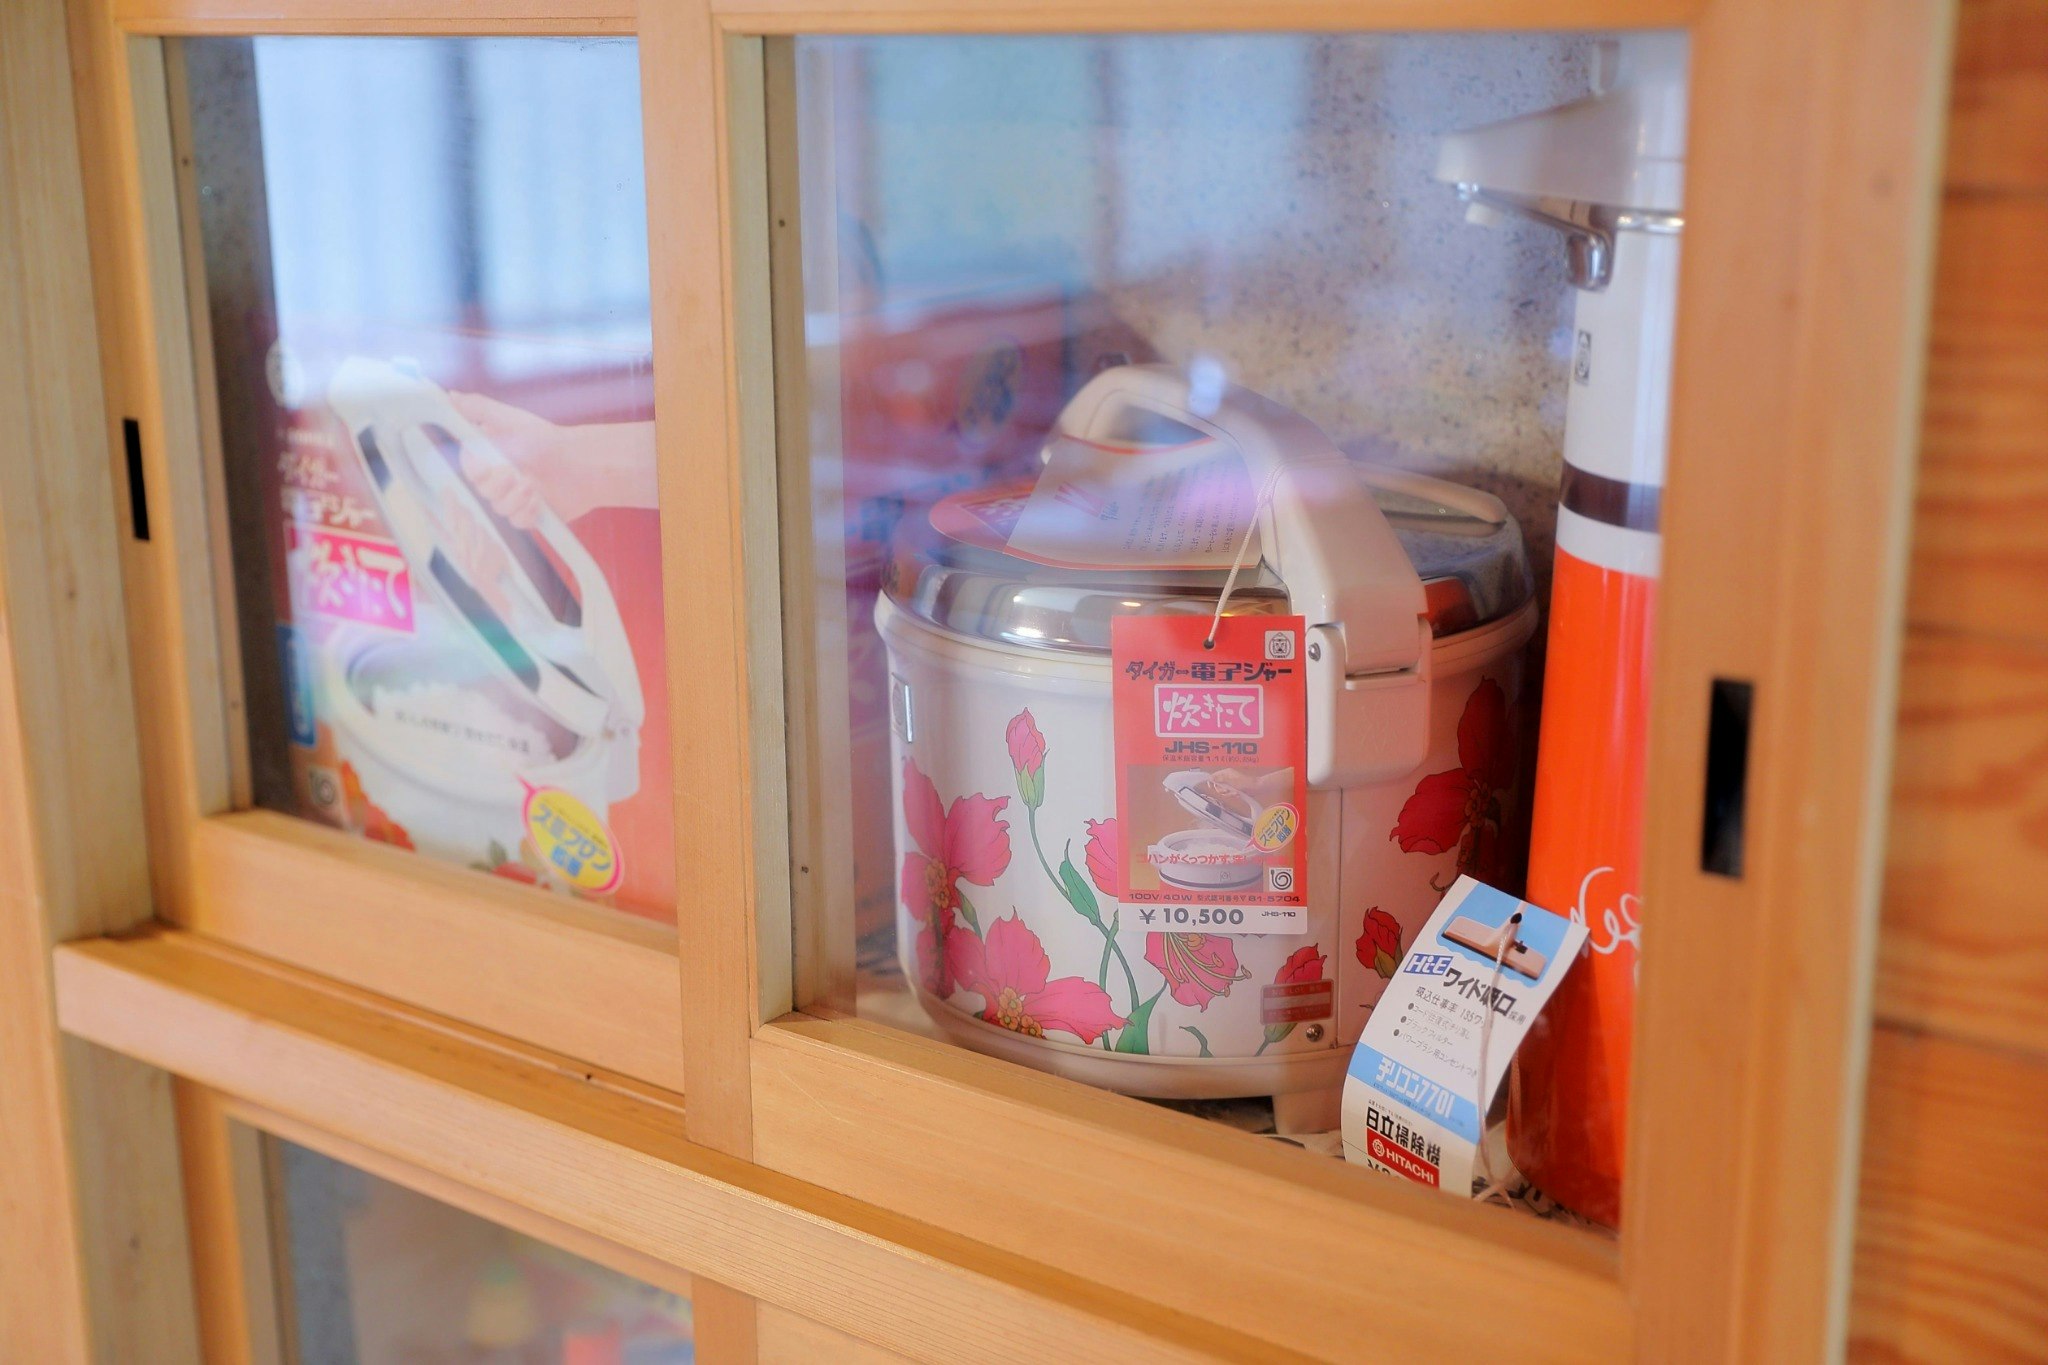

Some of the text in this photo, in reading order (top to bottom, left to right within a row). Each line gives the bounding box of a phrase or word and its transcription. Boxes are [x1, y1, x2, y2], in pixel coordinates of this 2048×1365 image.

[1162, 691, 1256, 731] 炊きたて
[1164, 741, 1258, 755] JHS-110
[1366, 1106, 1441, 1168] 日立掃除機
[1386, 1148, 1435, 1185] HITACHI
